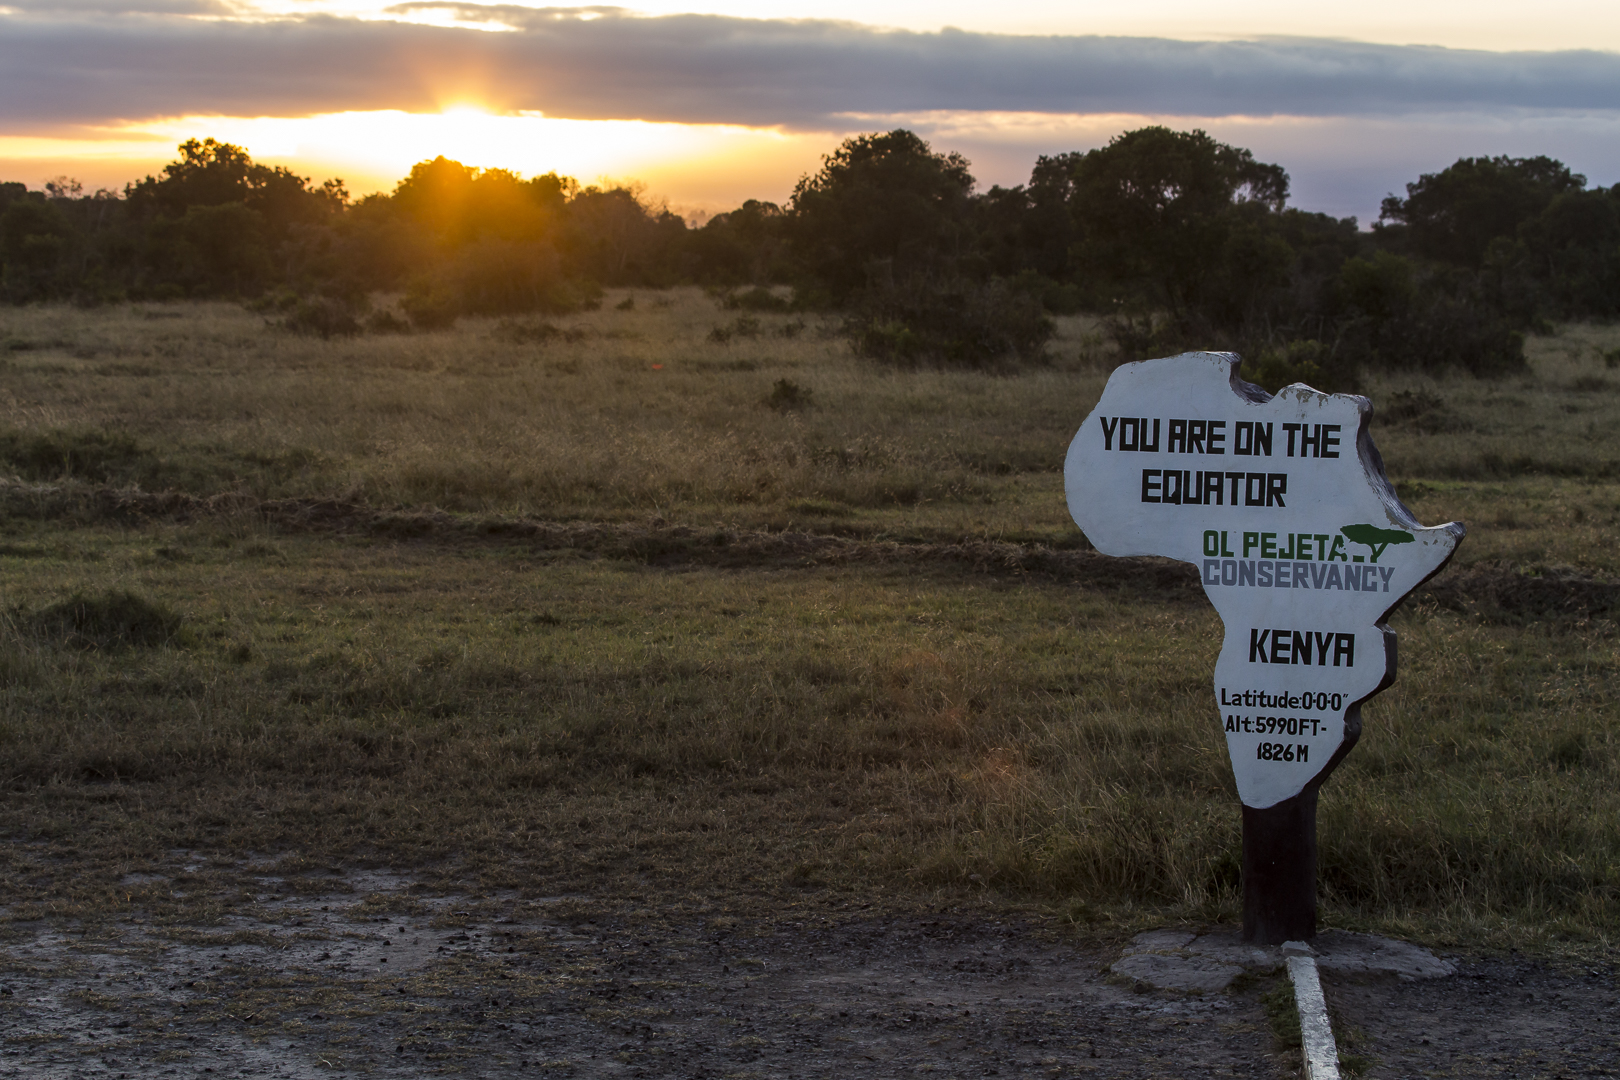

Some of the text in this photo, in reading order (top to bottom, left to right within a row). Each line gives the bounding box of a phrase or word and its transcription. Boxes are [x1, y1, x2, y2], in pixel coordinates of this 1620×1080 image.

[1100, 416, 1341, 458] YOU ARE ON THE
[1141, 468, 1287, 507] EQUATOR
[1203, 530, 1234, 558] OL
[1203, 559, 1395, 592] CONSERVANCY
[1249, 628, 1355, 667] KENYA
